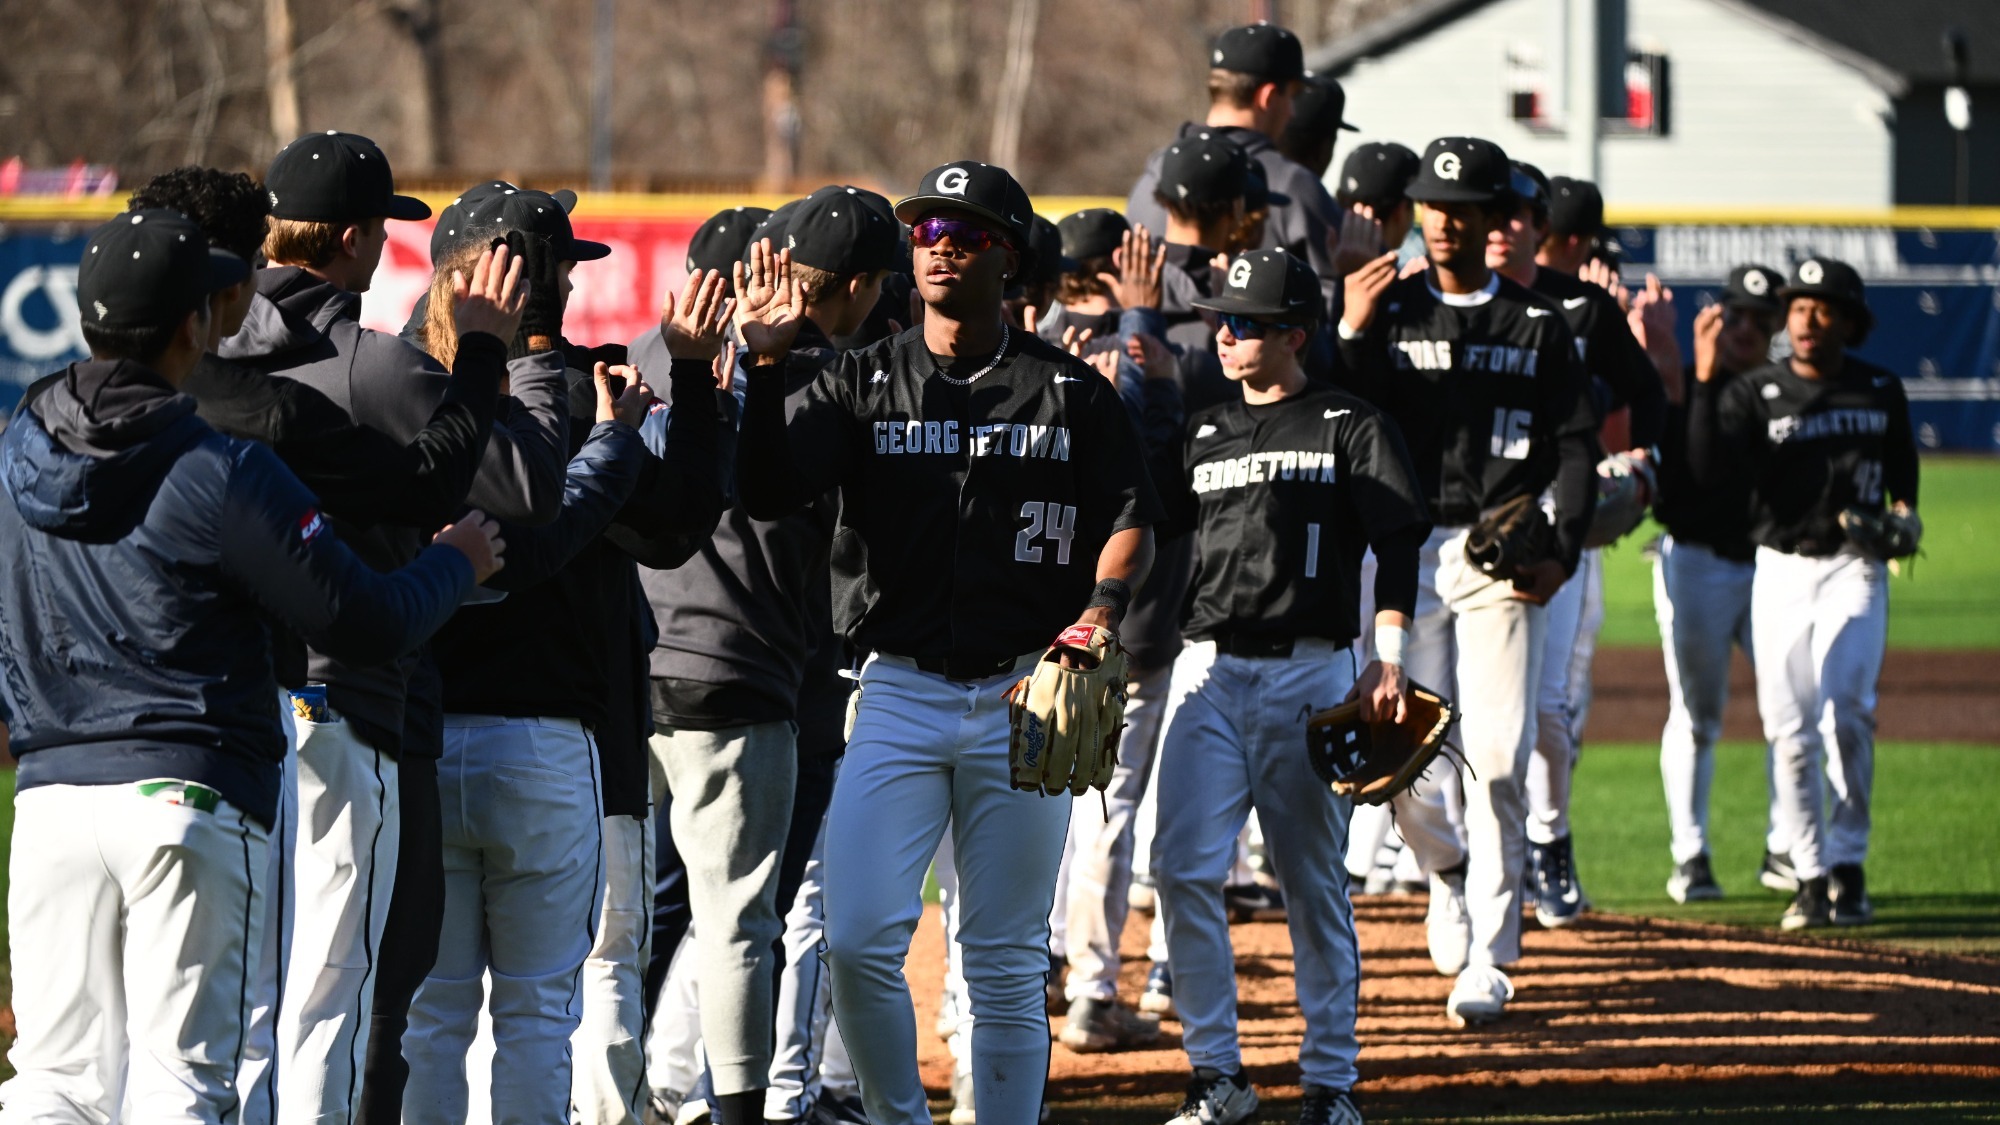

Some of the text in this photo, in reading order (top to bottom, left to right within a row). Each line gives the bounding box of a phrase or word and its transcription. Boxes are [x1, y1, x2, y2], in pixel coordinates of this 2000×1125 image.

[936, 167, 969, 196] G
[1433, 151, 1462, 181] G
[1228, 258, 1252, 290] G
[873, 420, 1071, 462] GEORGETOWN
[1490, 406, 1534, 460] 16
[1015, 501, 1077, 565] 24
[1305, 522, 1320, 578] 1
[1023, 711, 1046, 769] Rawlings
